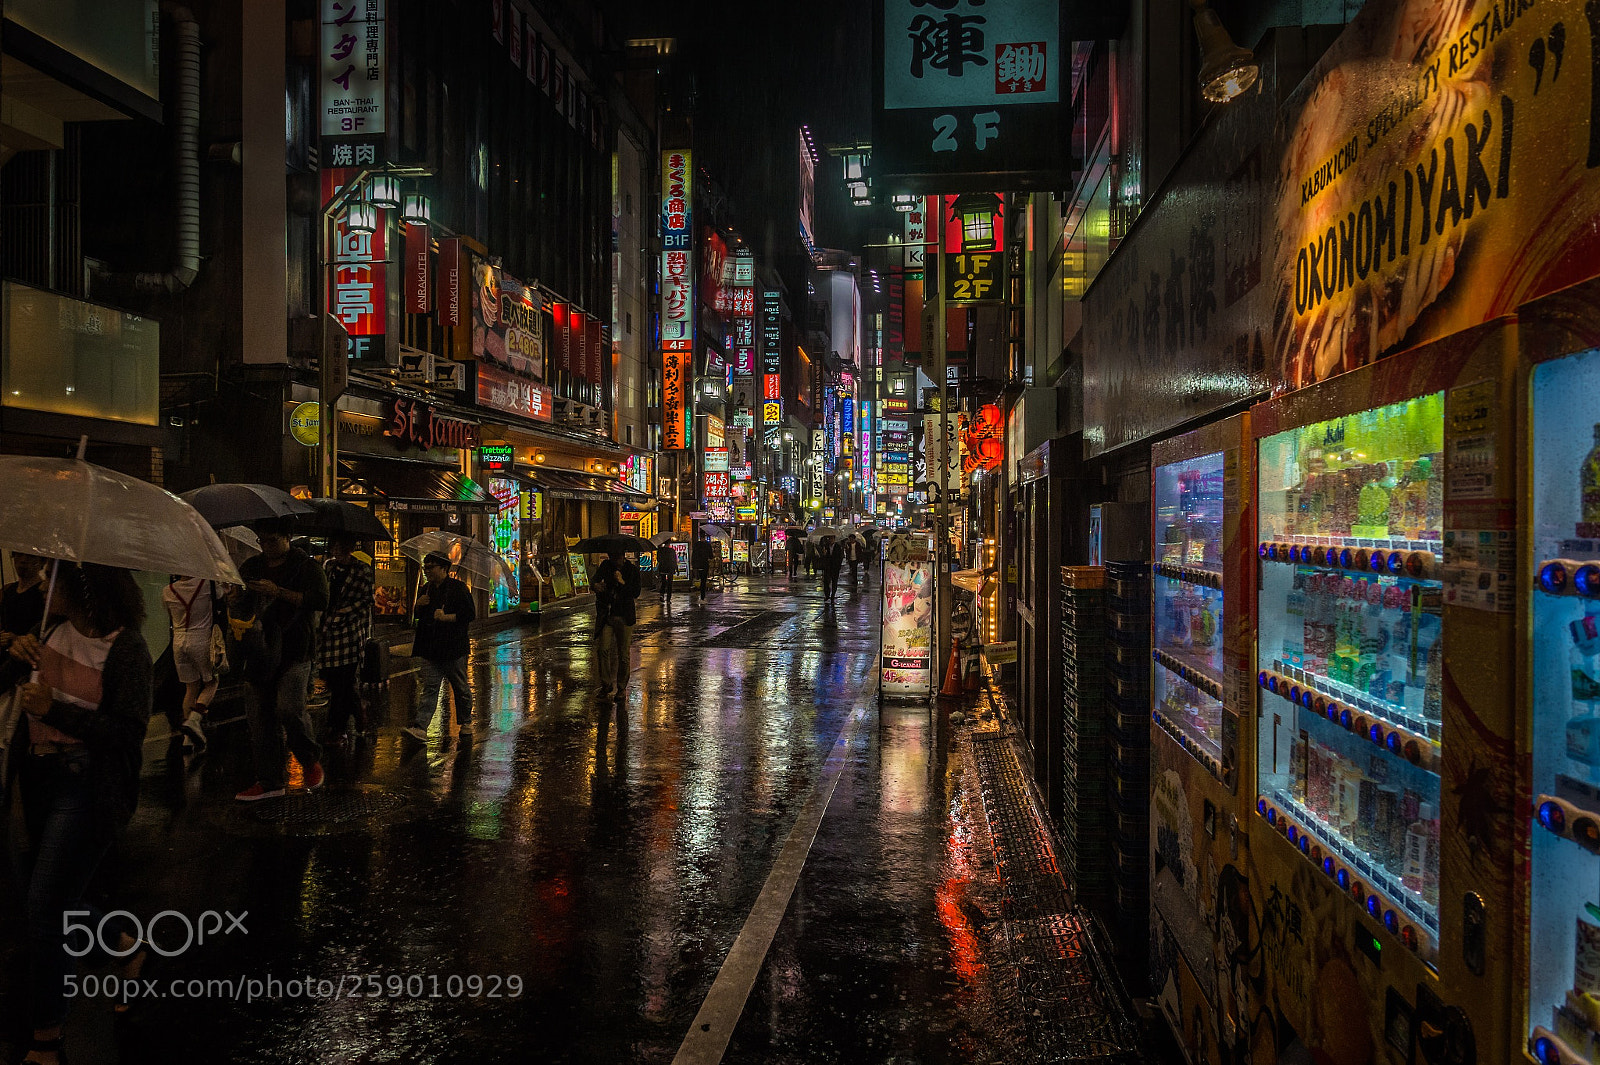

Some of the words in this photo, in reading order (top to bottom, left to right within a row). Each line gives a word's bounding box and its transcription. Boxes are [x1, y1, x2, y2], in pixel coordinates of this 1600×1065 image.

[907, 0, 988, 78] 陣
[1009, 81, 1034, 93] すき
[327, 106, 379, 115] RESTAURANT
[333, 98, 374, 107] BAN-THAI
[341, 117, 365, 132] 3F
[1301, 135, 1359, 207] KABUKICHO
[1367, 58, 1440, 149] SPECIALTY
[332, 143, 375, 166] 焼肉
[668, 153, 685, 231] まぐろ商店
[1295, 94, 1515, 316] OKONOMIYAKI
[664, 235, 689, 246] B1F
[955, 254, 991, 275] 1F
[418, 252, 426, 310] ANRAKUTEI
[953, 279, 993, 299] 2F
[450, 268, 459, 324] ANRAKUTEI
[669, 341, 685, 350] 4F
[292, 418, 320, 428] St.Jam
[481, 446, 512, 455] Trattoria
[483, 454, 510, 463] Pizzeria
